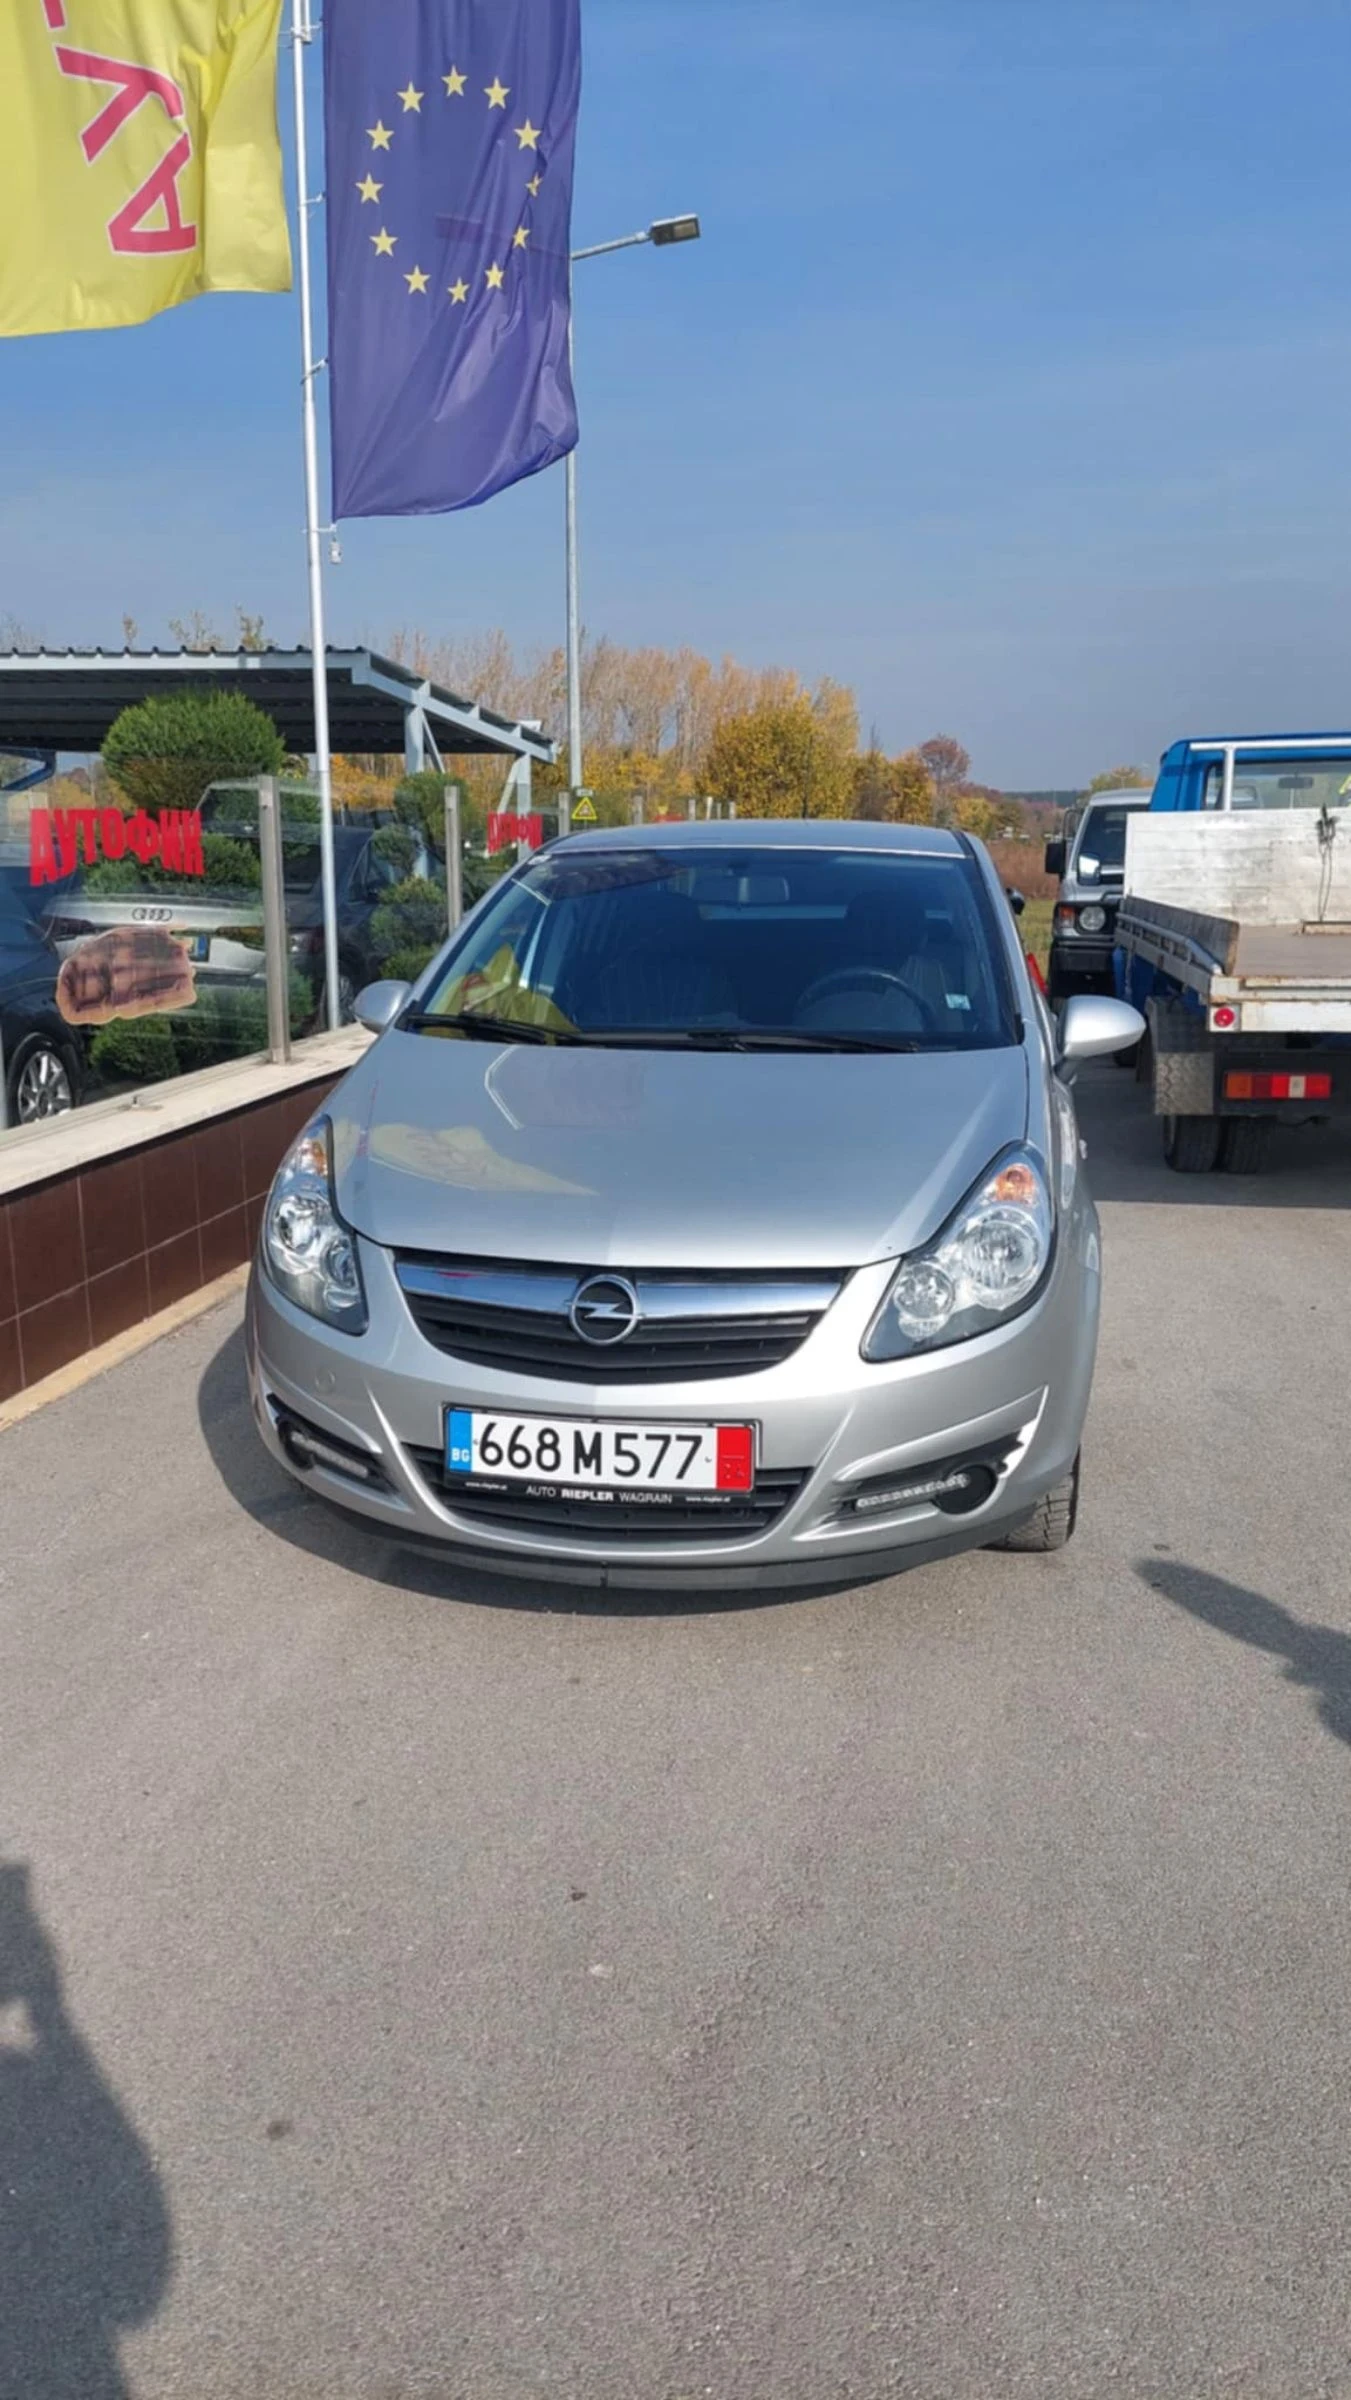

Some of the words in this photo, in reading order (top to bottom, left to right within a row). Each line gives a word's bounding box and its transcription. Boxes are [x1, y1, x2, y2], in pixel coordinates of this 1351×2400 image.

[30, 808, 205, 887] АУТОФИН
[451, 1447, 470, 1463] BG
[479, 1422, 561, 1472] 668
[573, 1430, 602, 1477] M
[614, 1432, 703, 1480] 577
[526, 1484, 557, 1498] AUTO
[561, 1488, 614, 1502] RIEPLER
[620, 1491, 673, 1504] WAGRAIN
